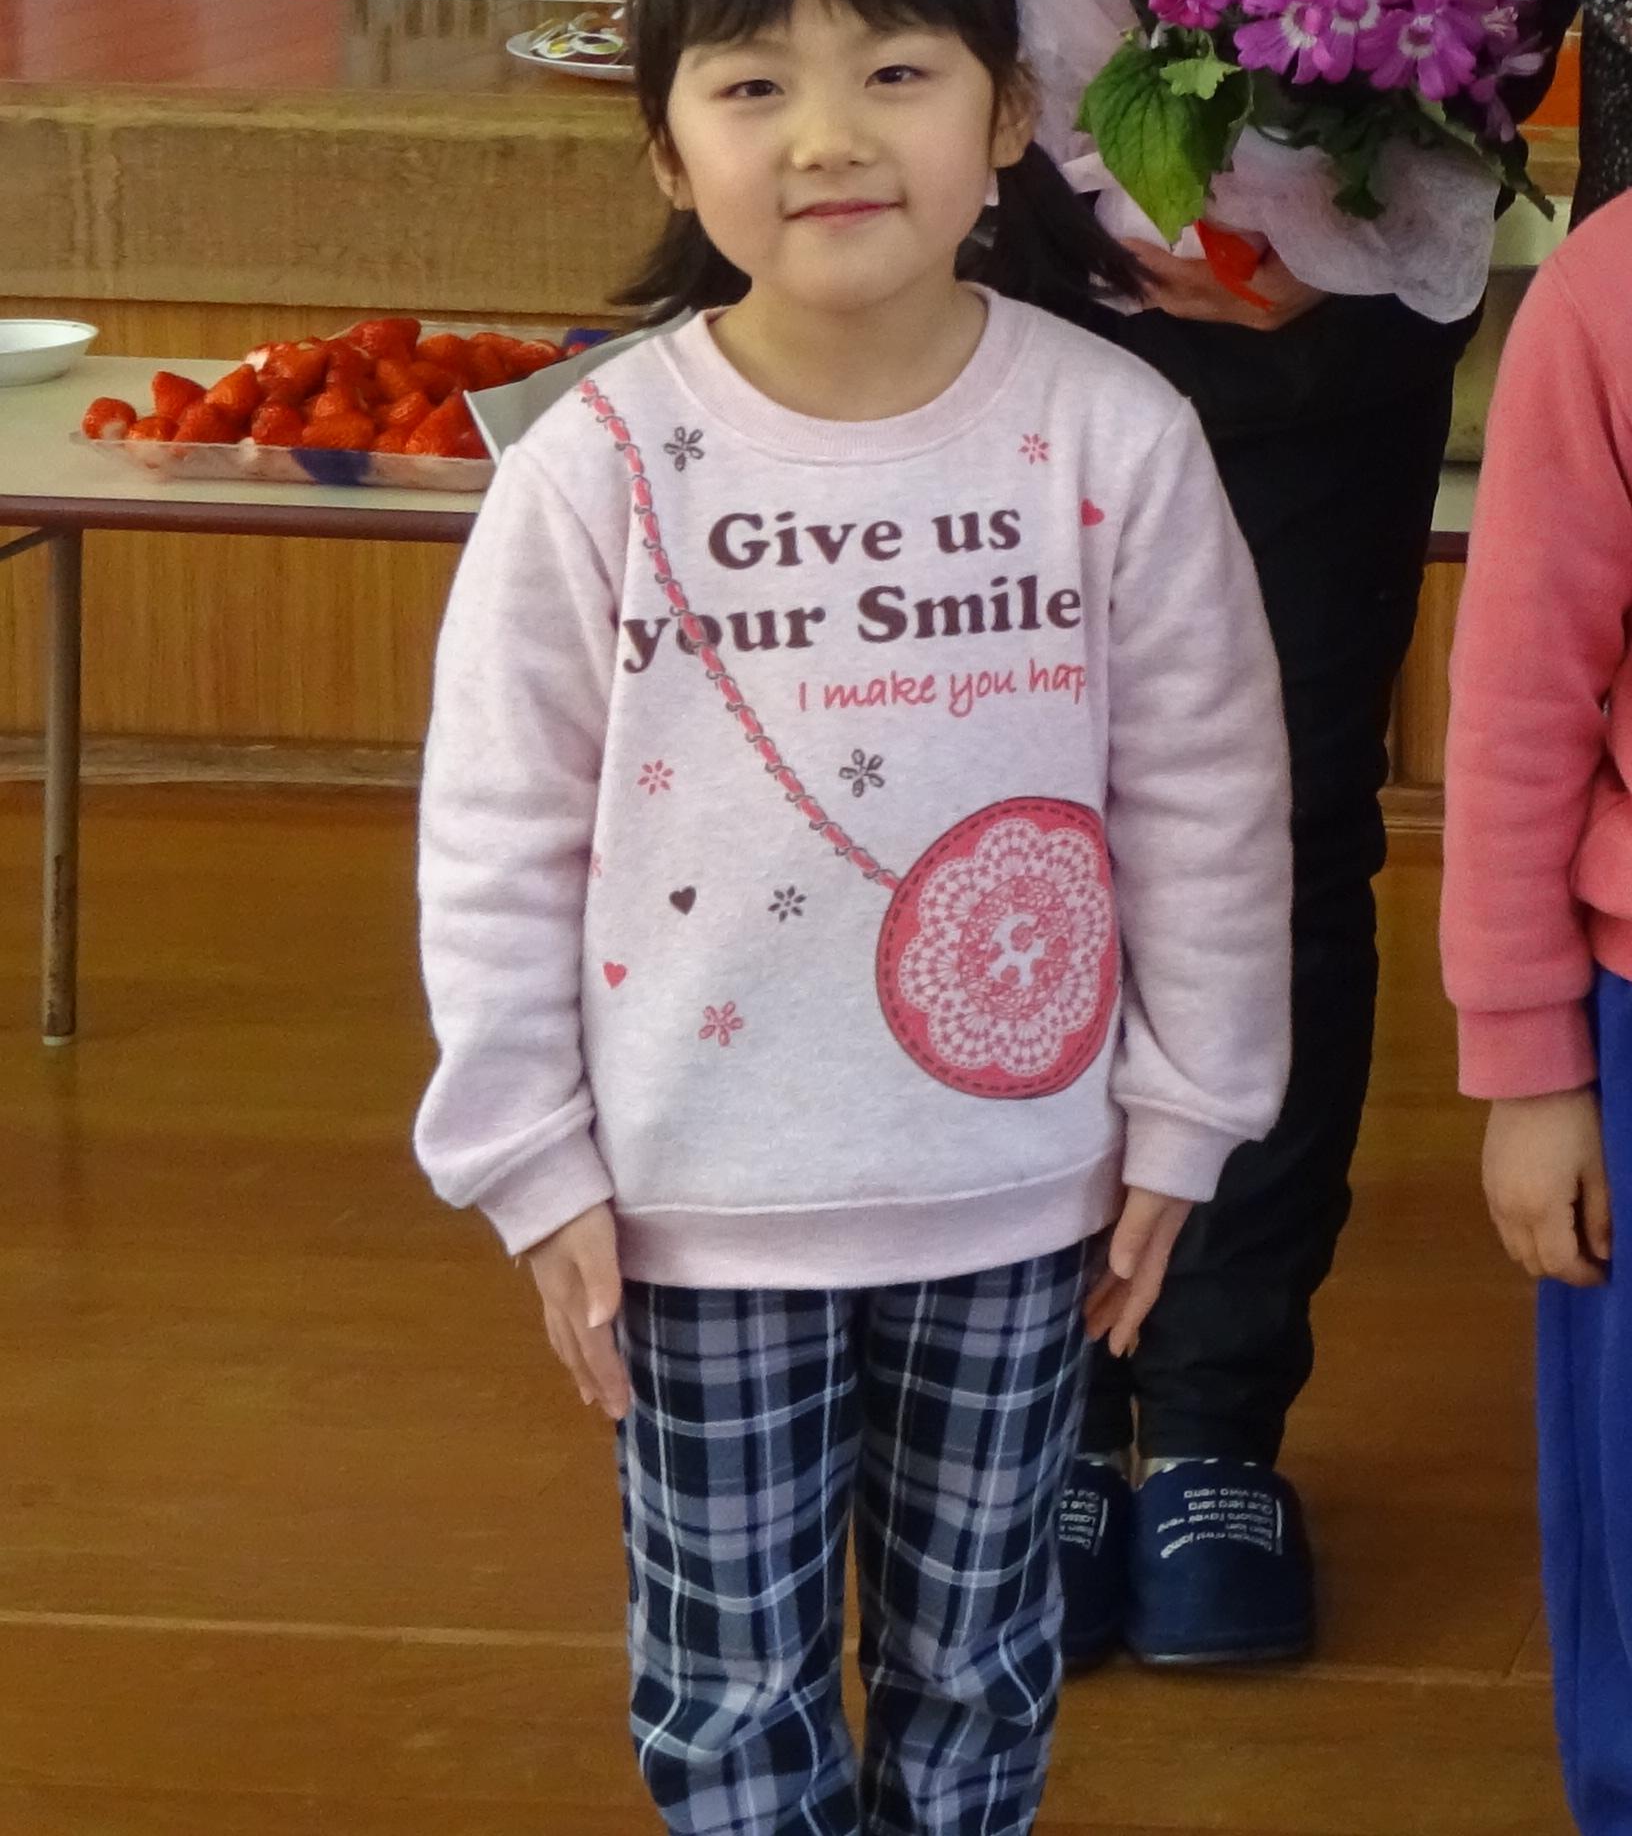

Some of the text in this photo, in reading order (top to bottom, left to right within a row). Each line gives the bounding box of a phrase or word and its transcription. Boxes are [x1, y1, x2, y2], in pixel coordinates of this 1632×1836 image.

[708, 506, 1022, 570] Give us
[622, 574, 1082, 673] your Smile
[799, 681, 807, 712] I
[823, 670, 937, 710] make
[949, 670, 1016, 718] you
